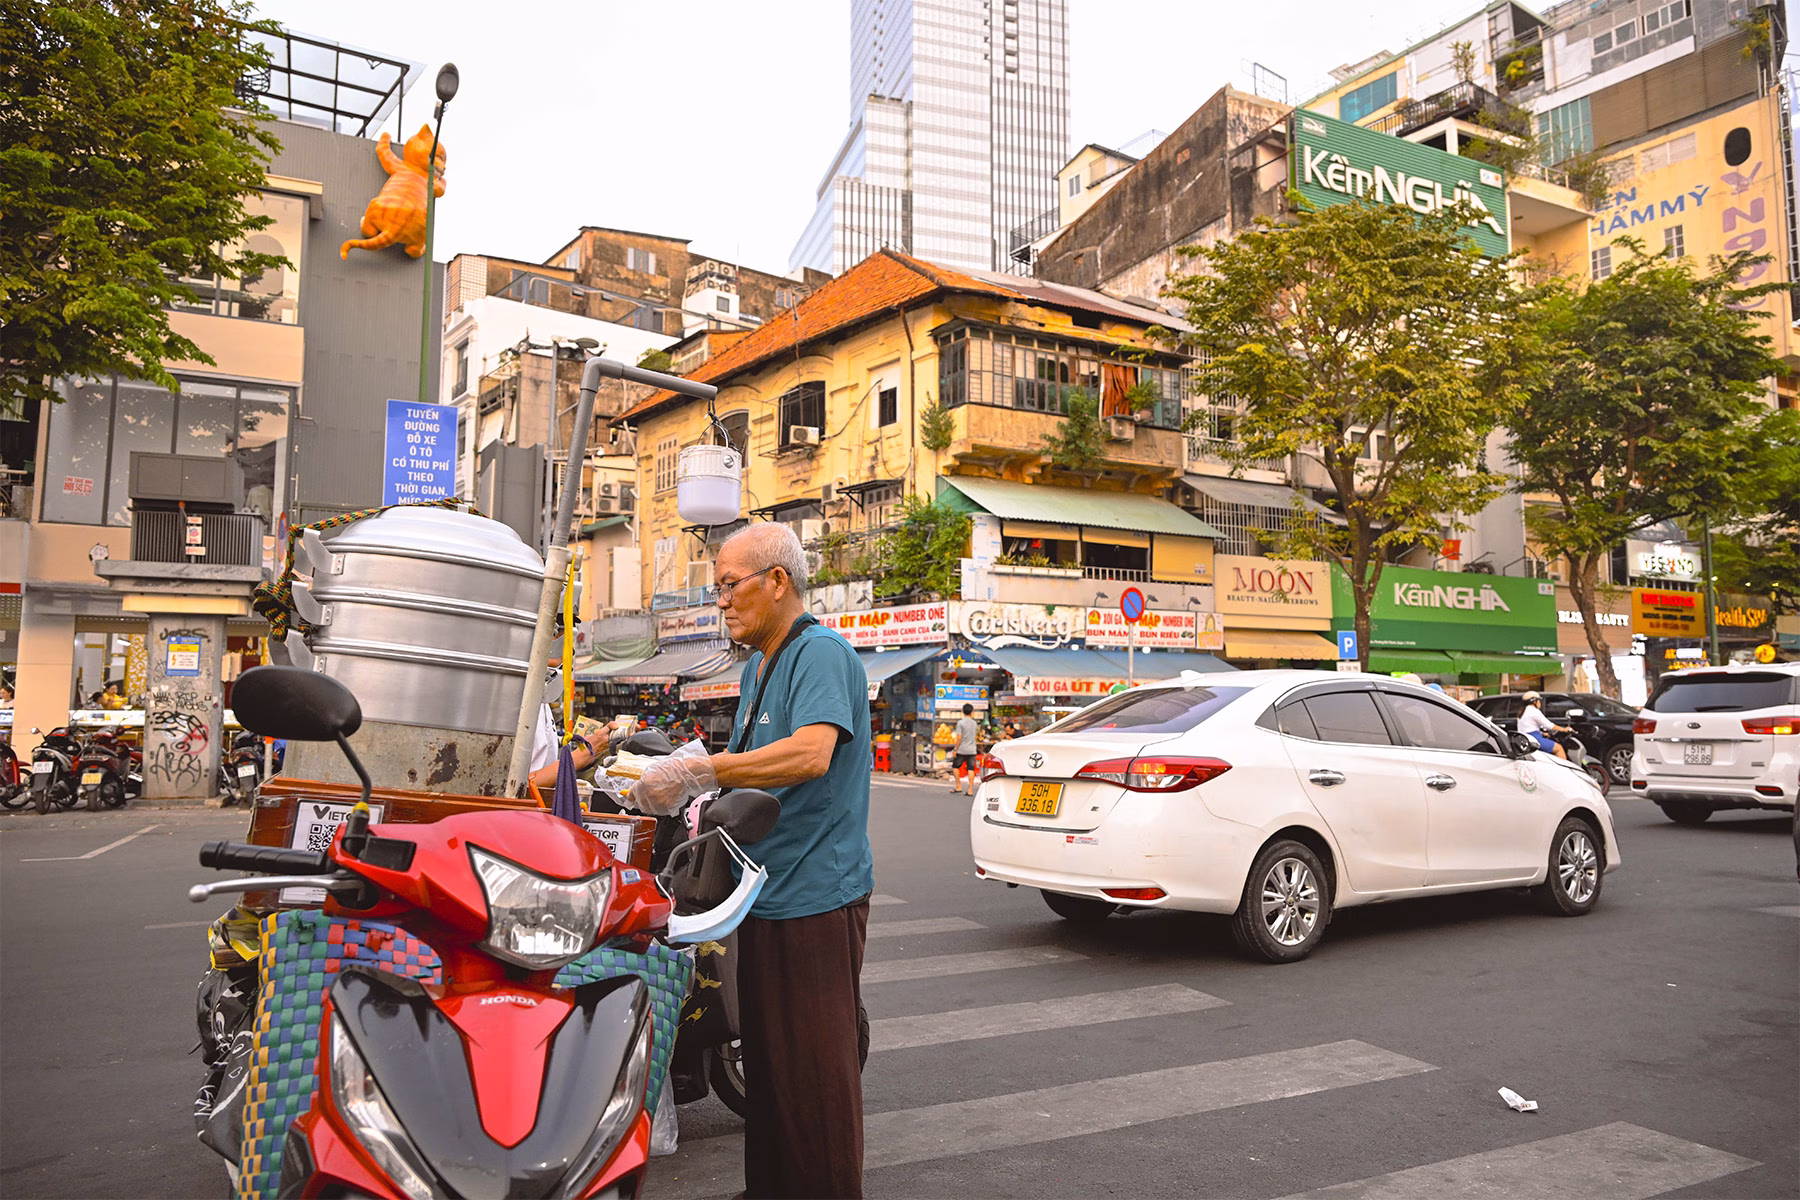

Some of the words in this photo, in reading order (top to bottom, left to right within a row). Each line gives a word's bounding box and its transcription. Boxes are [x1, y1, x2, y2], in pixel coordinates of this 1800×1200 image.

[406, 408, 439, 420] TUYẾN
[404, 420, 440, 433] ĐƯỜNG
[424, 436, 437, 445] XE
[409, 445, 416, 456] Ô
[419, 446, 432, 457] TÔ
[392, 456, 407, 468] CÓ
[410, 459, 429, 469] THU
[432, 460, 450, 471] PHÍ
[407, 472, 434, 482] THEO
[395, 482, 418, 493] THỜI
[1232, 567, 1313, 595] MOON
[840, 613, 857, 628] ÚT
[893, 609, 926, 623] NUMBER
[928, 606, 945, 620] ONE
[959, 600, 1072, 644] Carlsberg
[1162, 615, 1183, 627] NUMBER
[1184, 616, 1194, 628] ONE
[1595, 612, 1630, 626] EAUTY
[1344, 637, 1353, 653] P
[1032, 680, 1050, 692] XÔI
[1071, 678, 1094, 692] ÚT
[1691, 745, 1706, 753] 51H
[1031, 784, 1050, 798] 50H
[1020, 798, 1053, 813] 336.18
[313, 805, 352, 821] VIET
[480, 995, 538, 1006] HONDA
